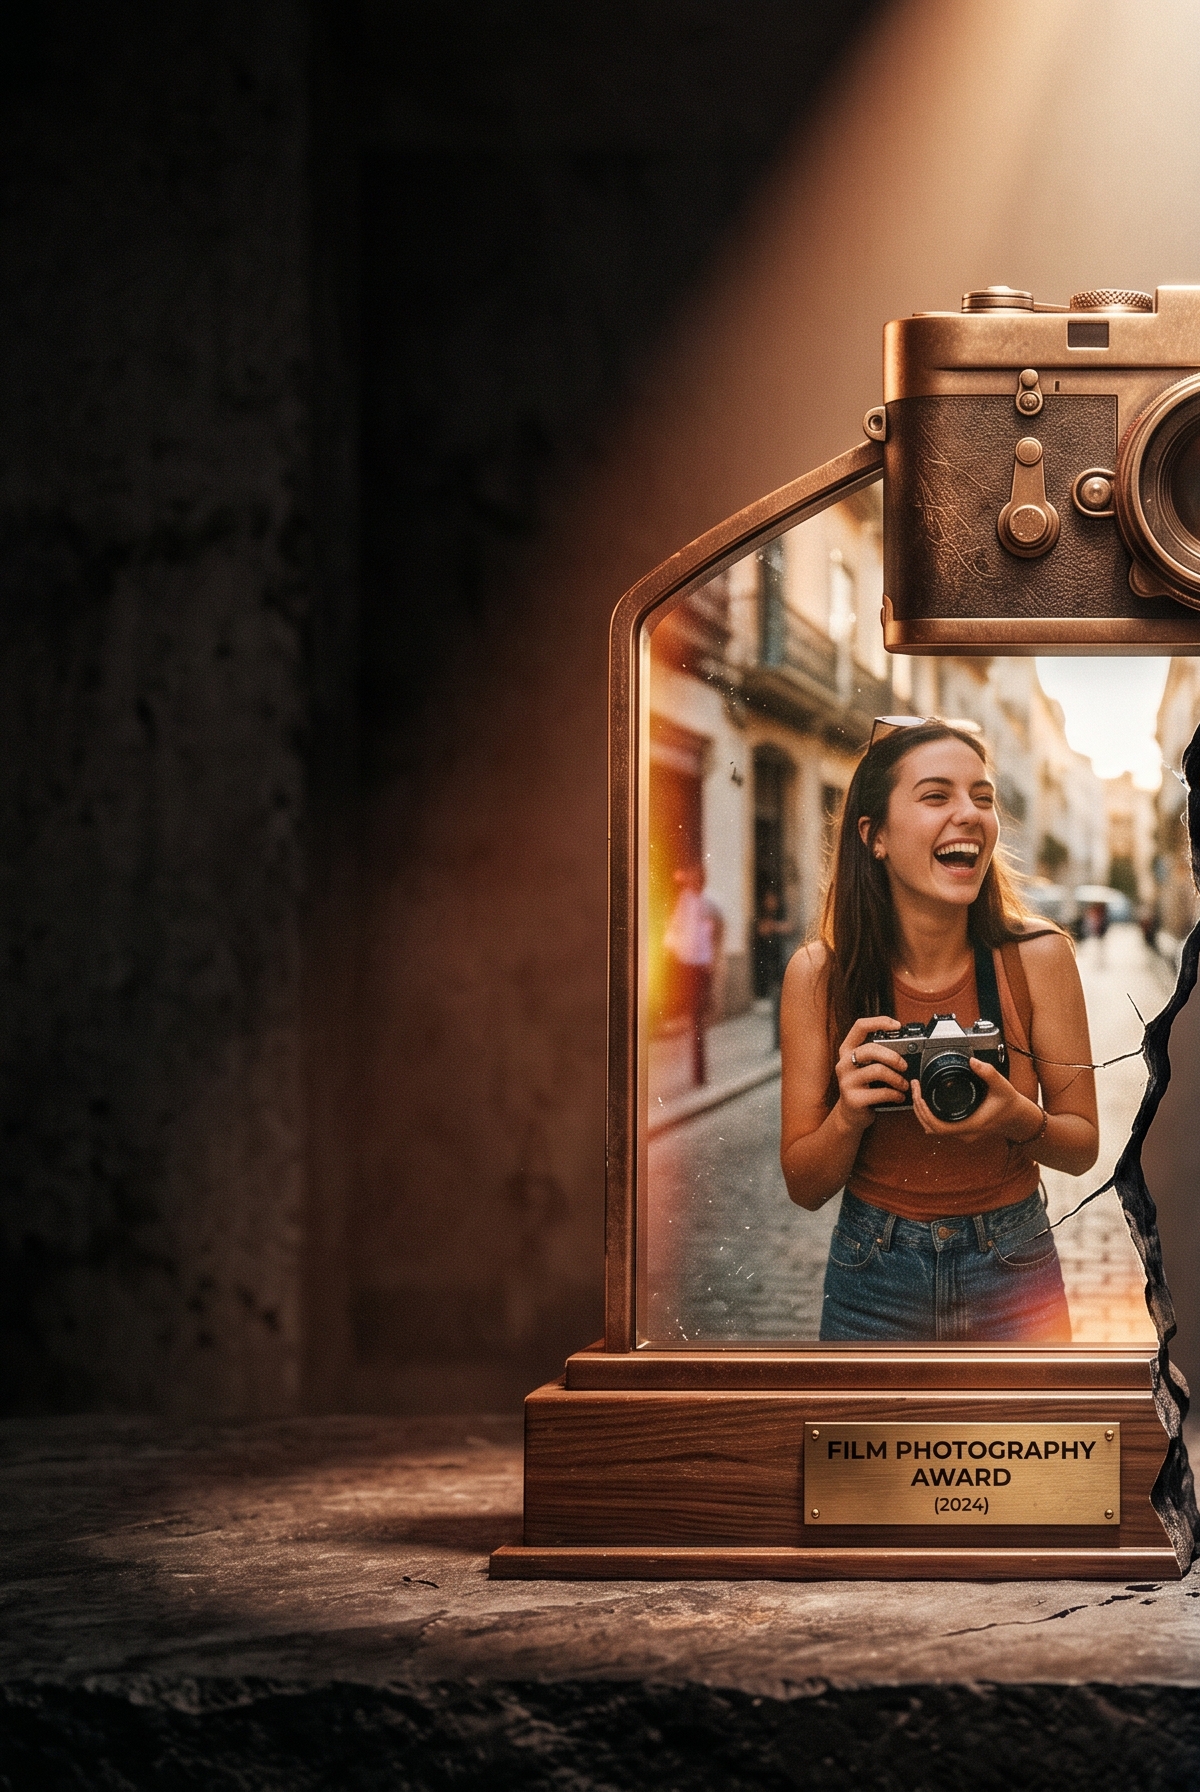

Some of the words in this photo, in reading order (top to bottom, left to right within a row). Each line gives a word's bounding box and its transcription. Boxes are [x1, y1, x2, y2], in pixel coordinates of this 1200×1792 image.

[827, 1441, 887, 1460] FILM
[896, 1440, 1096, 1460] PHOTOGRAPHY
[911, 1468, 1012, 1487] AWARD
[934, 1497, 989, 1515] (2024)
